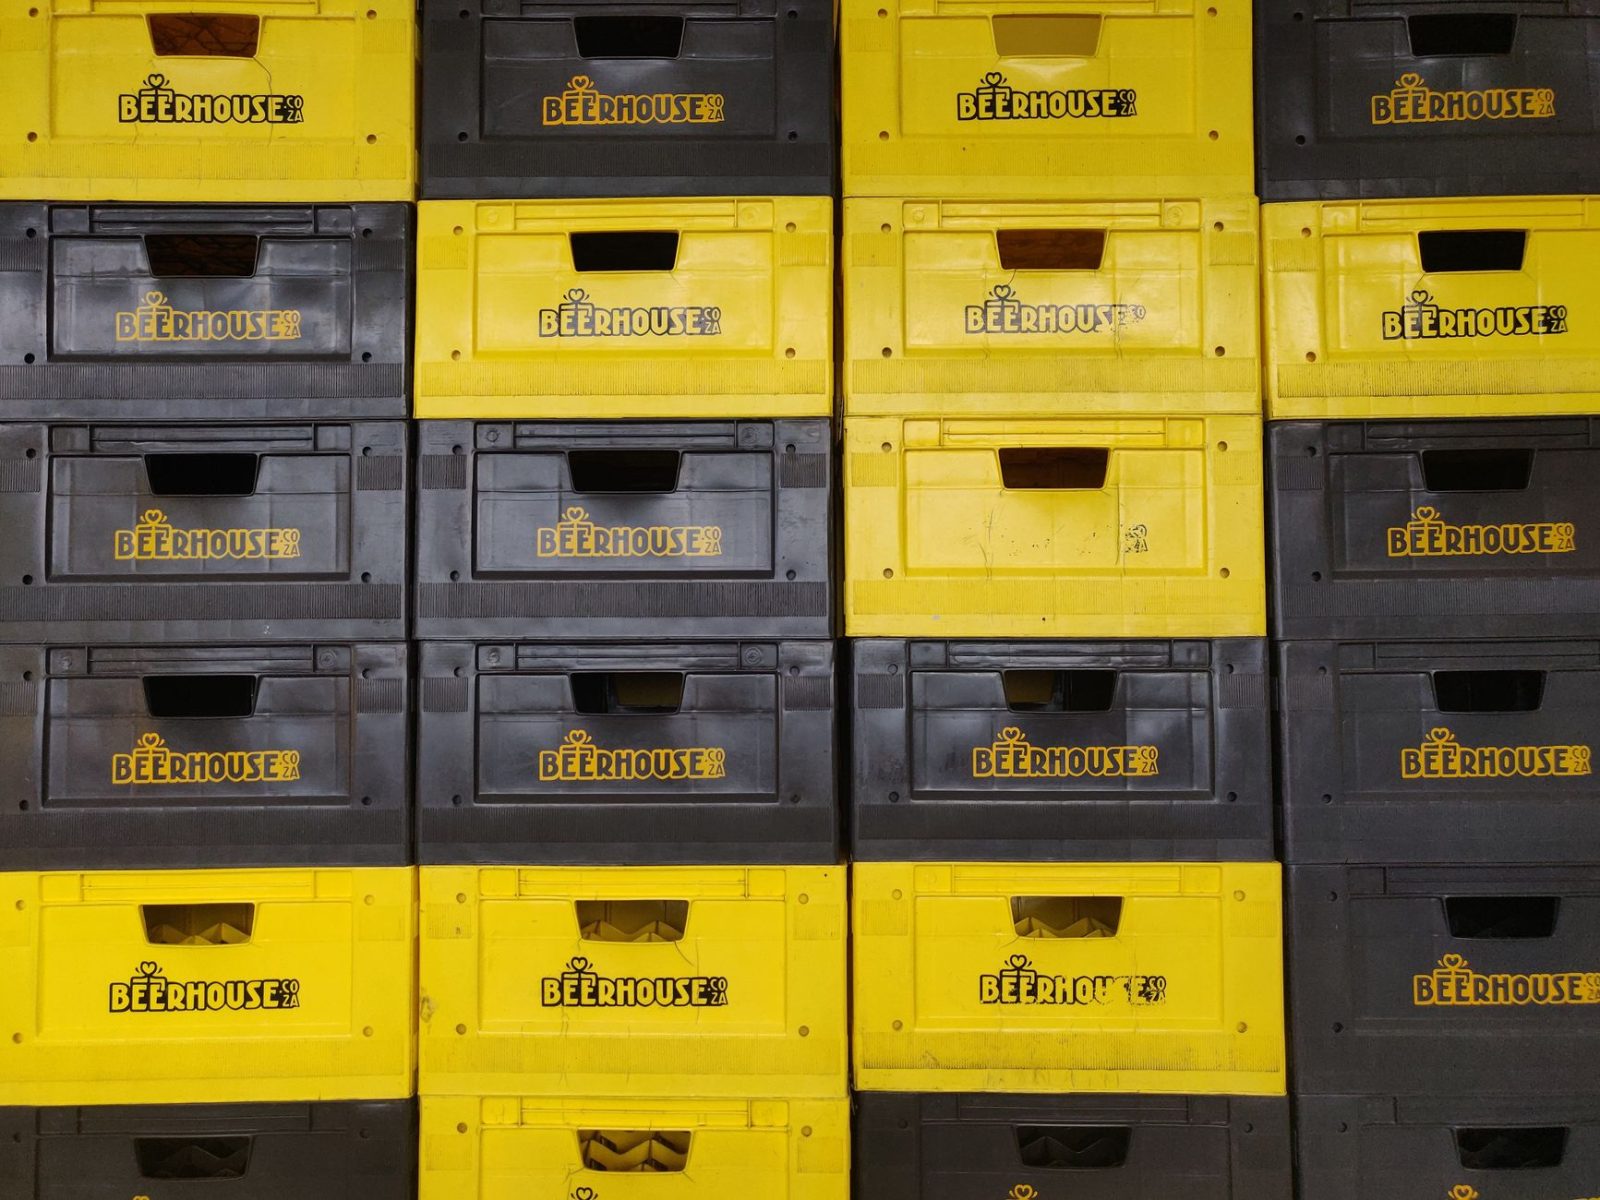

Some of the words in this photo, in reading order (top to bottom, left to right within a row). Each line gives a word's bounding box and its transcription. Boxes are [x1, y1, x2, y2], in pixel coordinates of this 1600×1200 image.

[120, 95, 286, 124] BEERHOUSE
[543, 95, 704, 125] BEERHOUSE
[957, 90, 1117, 121] BEERHOUSE
[1372, 90, 1535, 125] BEERHOUSE
[116, 310, 280, 342] BEERHOUSE
[539, 308, 702, 338] BEERHOUSE
[1383, 307, 1547, 341] BEERHOUSE
[115, 528, 279, 559] BEERHOUSE
[537, 526, 702, 558] BEERHOUSE
[1388, 523, 1554, 557] BEERHOUSE
[112, 751, 279, 784] BEERHOUSE
[539, 749, 705, 781] BEERHOUSE
[973, 746, 1138, 778] BEERHOUSE
[1403, 746, 1571, 779] BEERHOUSE
[110, 980, 280, 1013] BEERHOUSE
[541, 977, 708, 1007] BEERHOUSE
[1413, 974, 1584, 1006] BEERHOUSE
